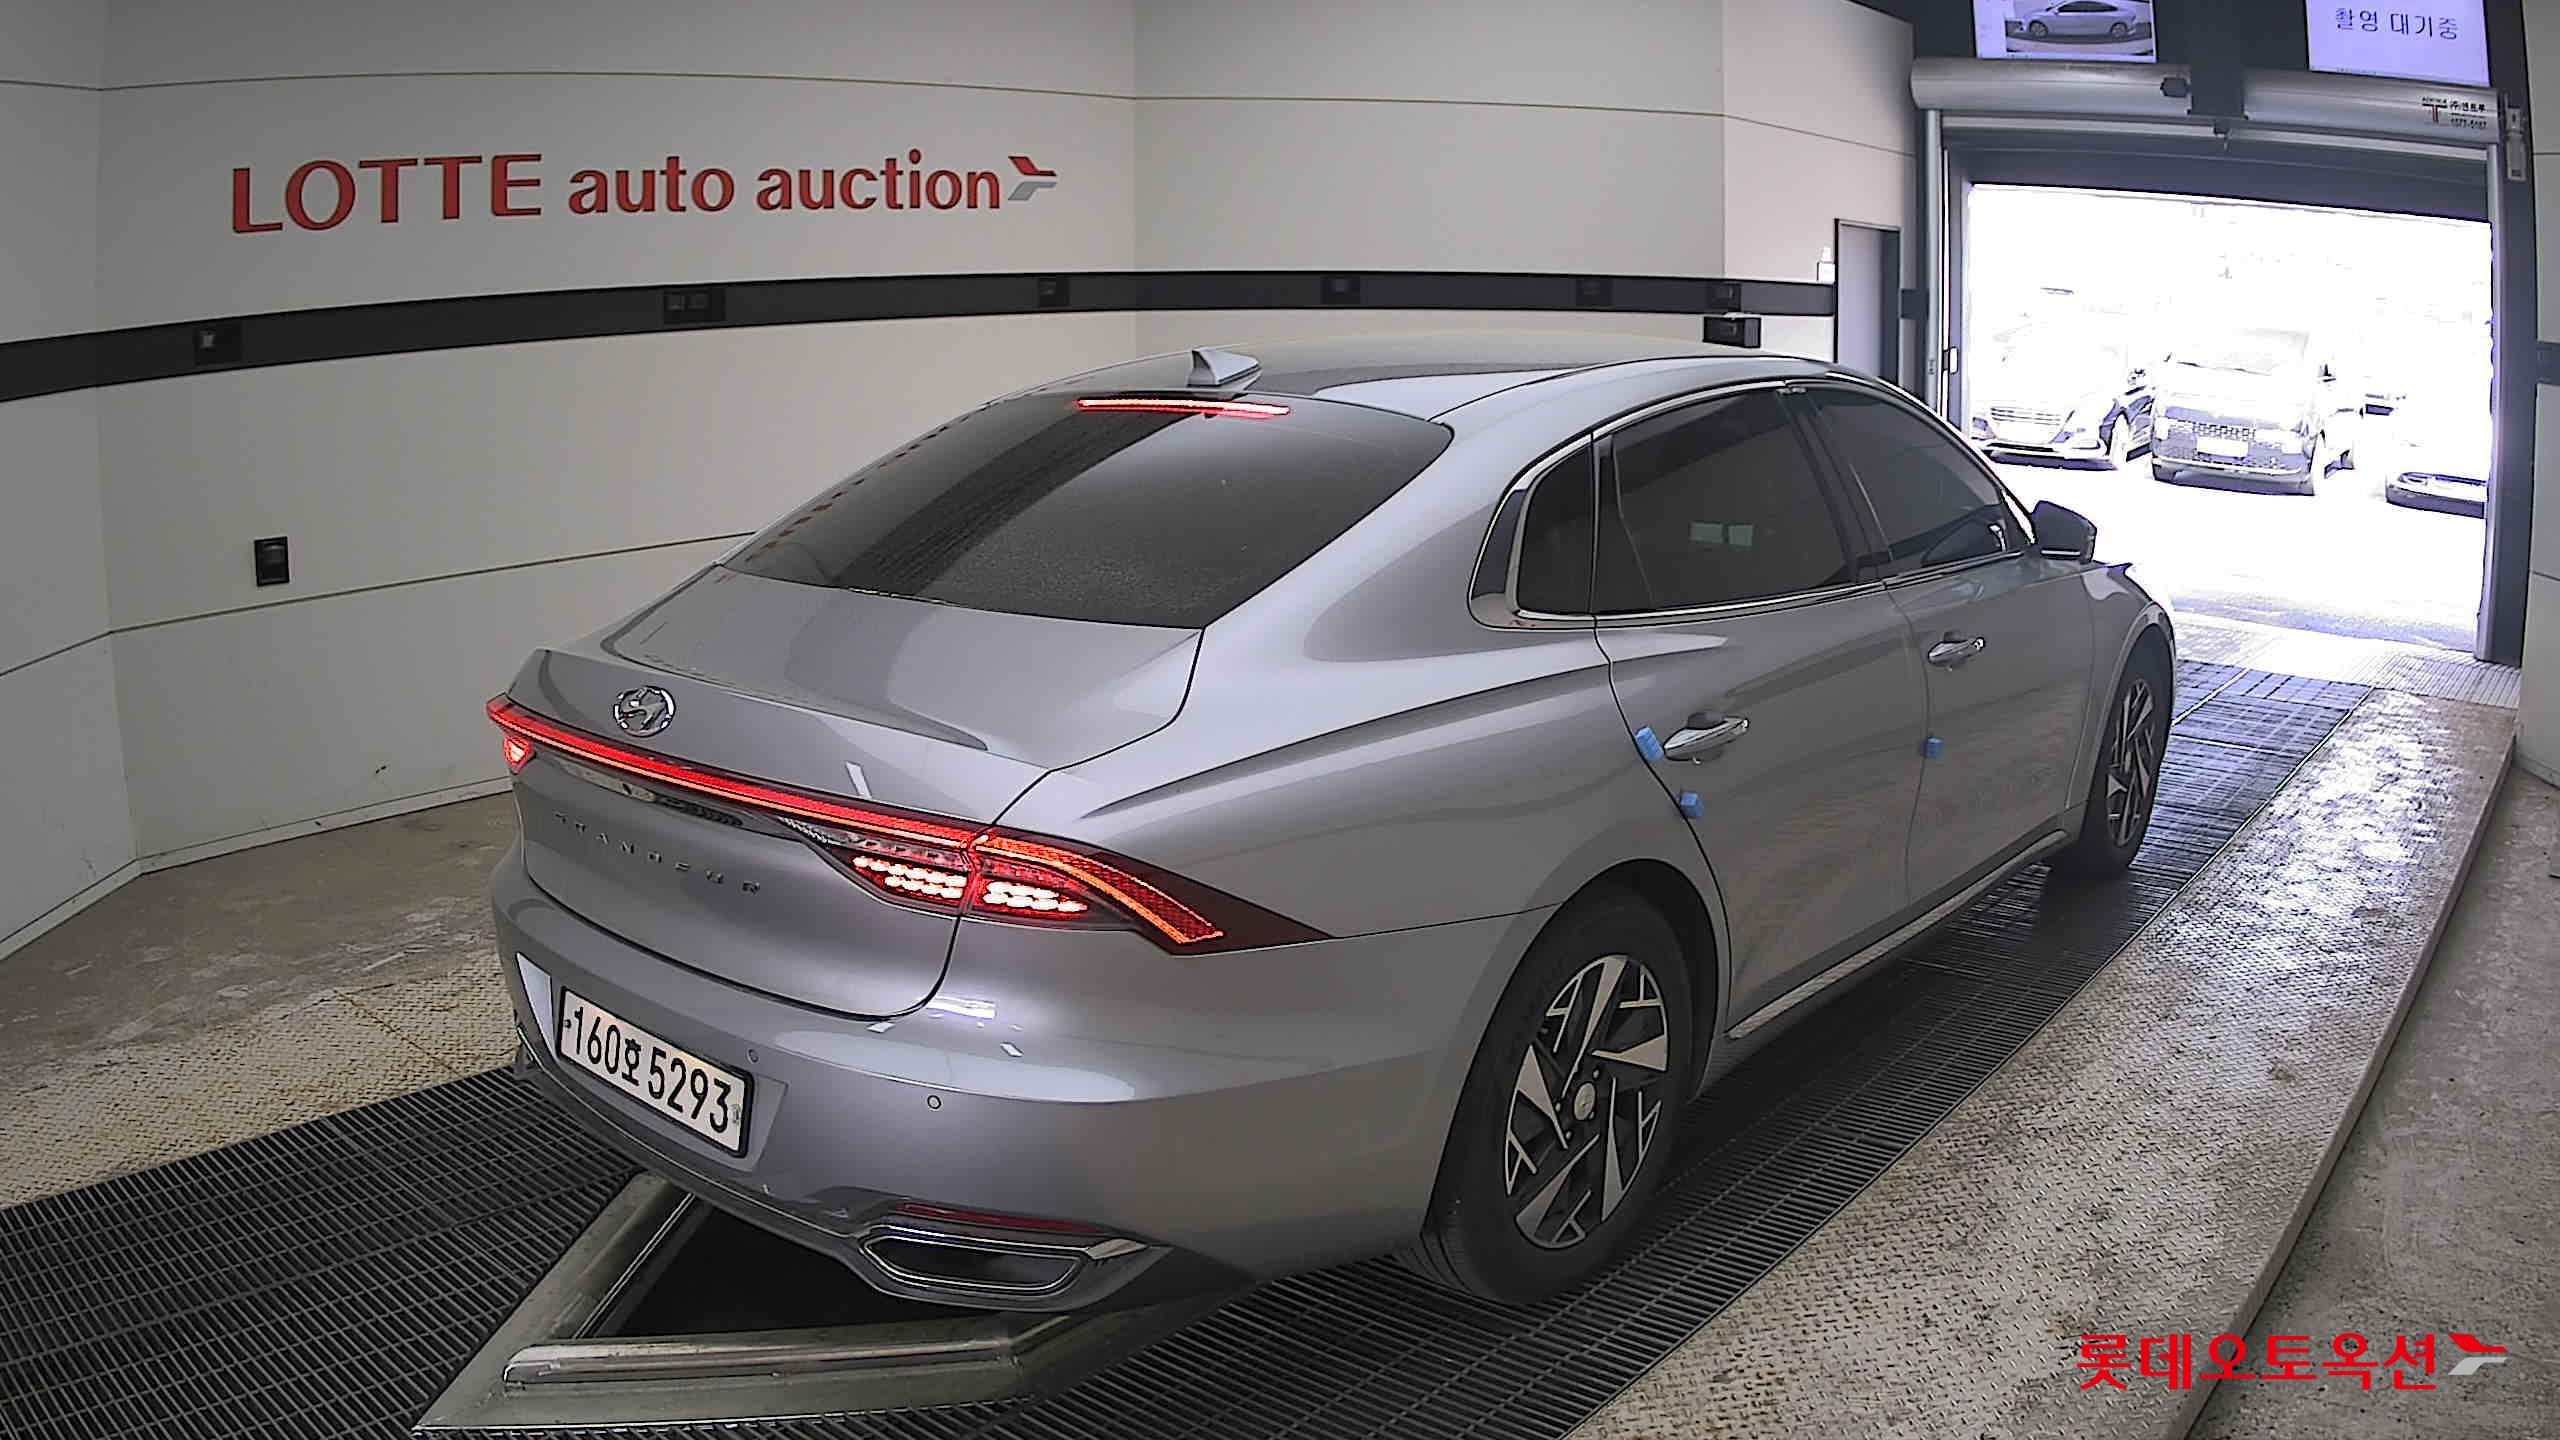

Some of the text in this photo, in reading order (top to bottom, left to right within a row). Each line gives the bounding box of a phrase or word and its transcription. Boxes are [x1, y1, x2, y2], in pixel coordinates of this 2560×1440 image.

[2335, 8, 2458, 40] 촬영 대기중
[232, 147, 1002, 234] LOTTE auto auction
[573, 1006, 732, 1133] 160호 5293
